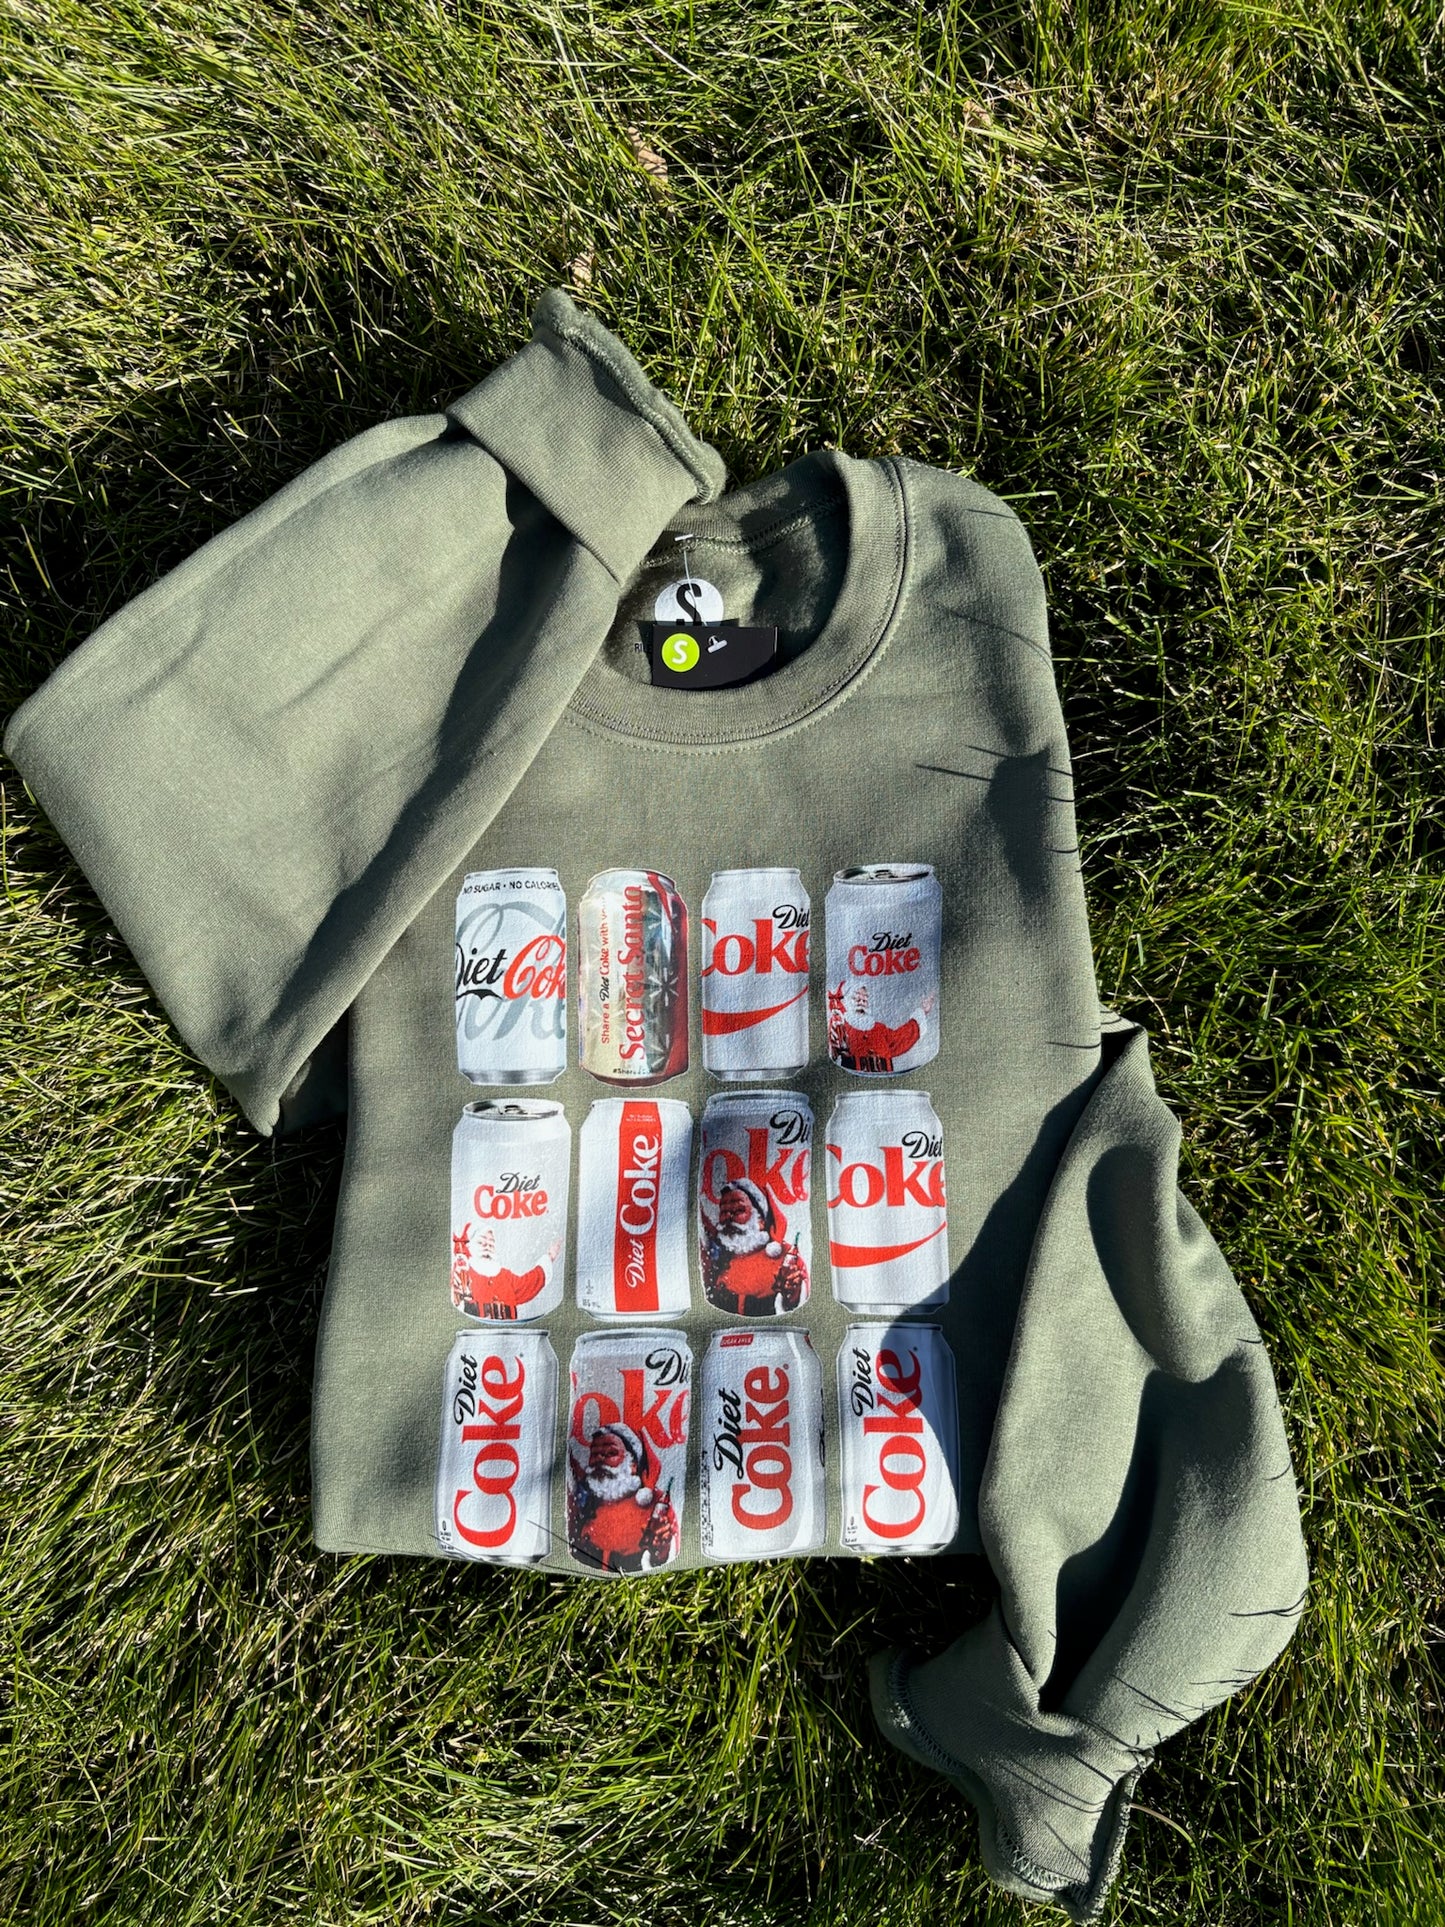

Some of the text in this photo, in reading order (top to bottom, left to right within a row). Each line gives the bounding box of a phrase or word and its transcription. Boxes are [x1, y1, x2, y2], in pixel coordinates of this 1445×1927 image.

[671, 640, 688, 665] S
[473, 882, 502, 894] SUGAR
[509, 881, 523, 890] NO
[600, 922, 609, 946] with
[617, 885, 646, 967] Santa
[869, 931, 912, 952] Diet
[503, 935, 566, 1000] Cok
[600, 947, 610, 976] Coke
[848, 945, 921, 976] Coke
[600, 977, 610, 1002] Diet
[601, 1013, 610, 1044] Share
[619, 970, 646, 1060] Secret
[474, 1185, 548, 1219] Coke
[495, 1172, 540, 1193] Diet
[620, 1134, 663, 1236] Coke
[624, 1238, 646, 1288] Diet
[453, 1354, 479, 1426] Diet
[851, 1347, 874, 1417] Diet
[453, 1355, 526, 1548] Coke
[713, 1387, 744, 1480] Diet
[731, 1366, 793, 1531] Coke
[862, 1349, 927, 1539] Coke
